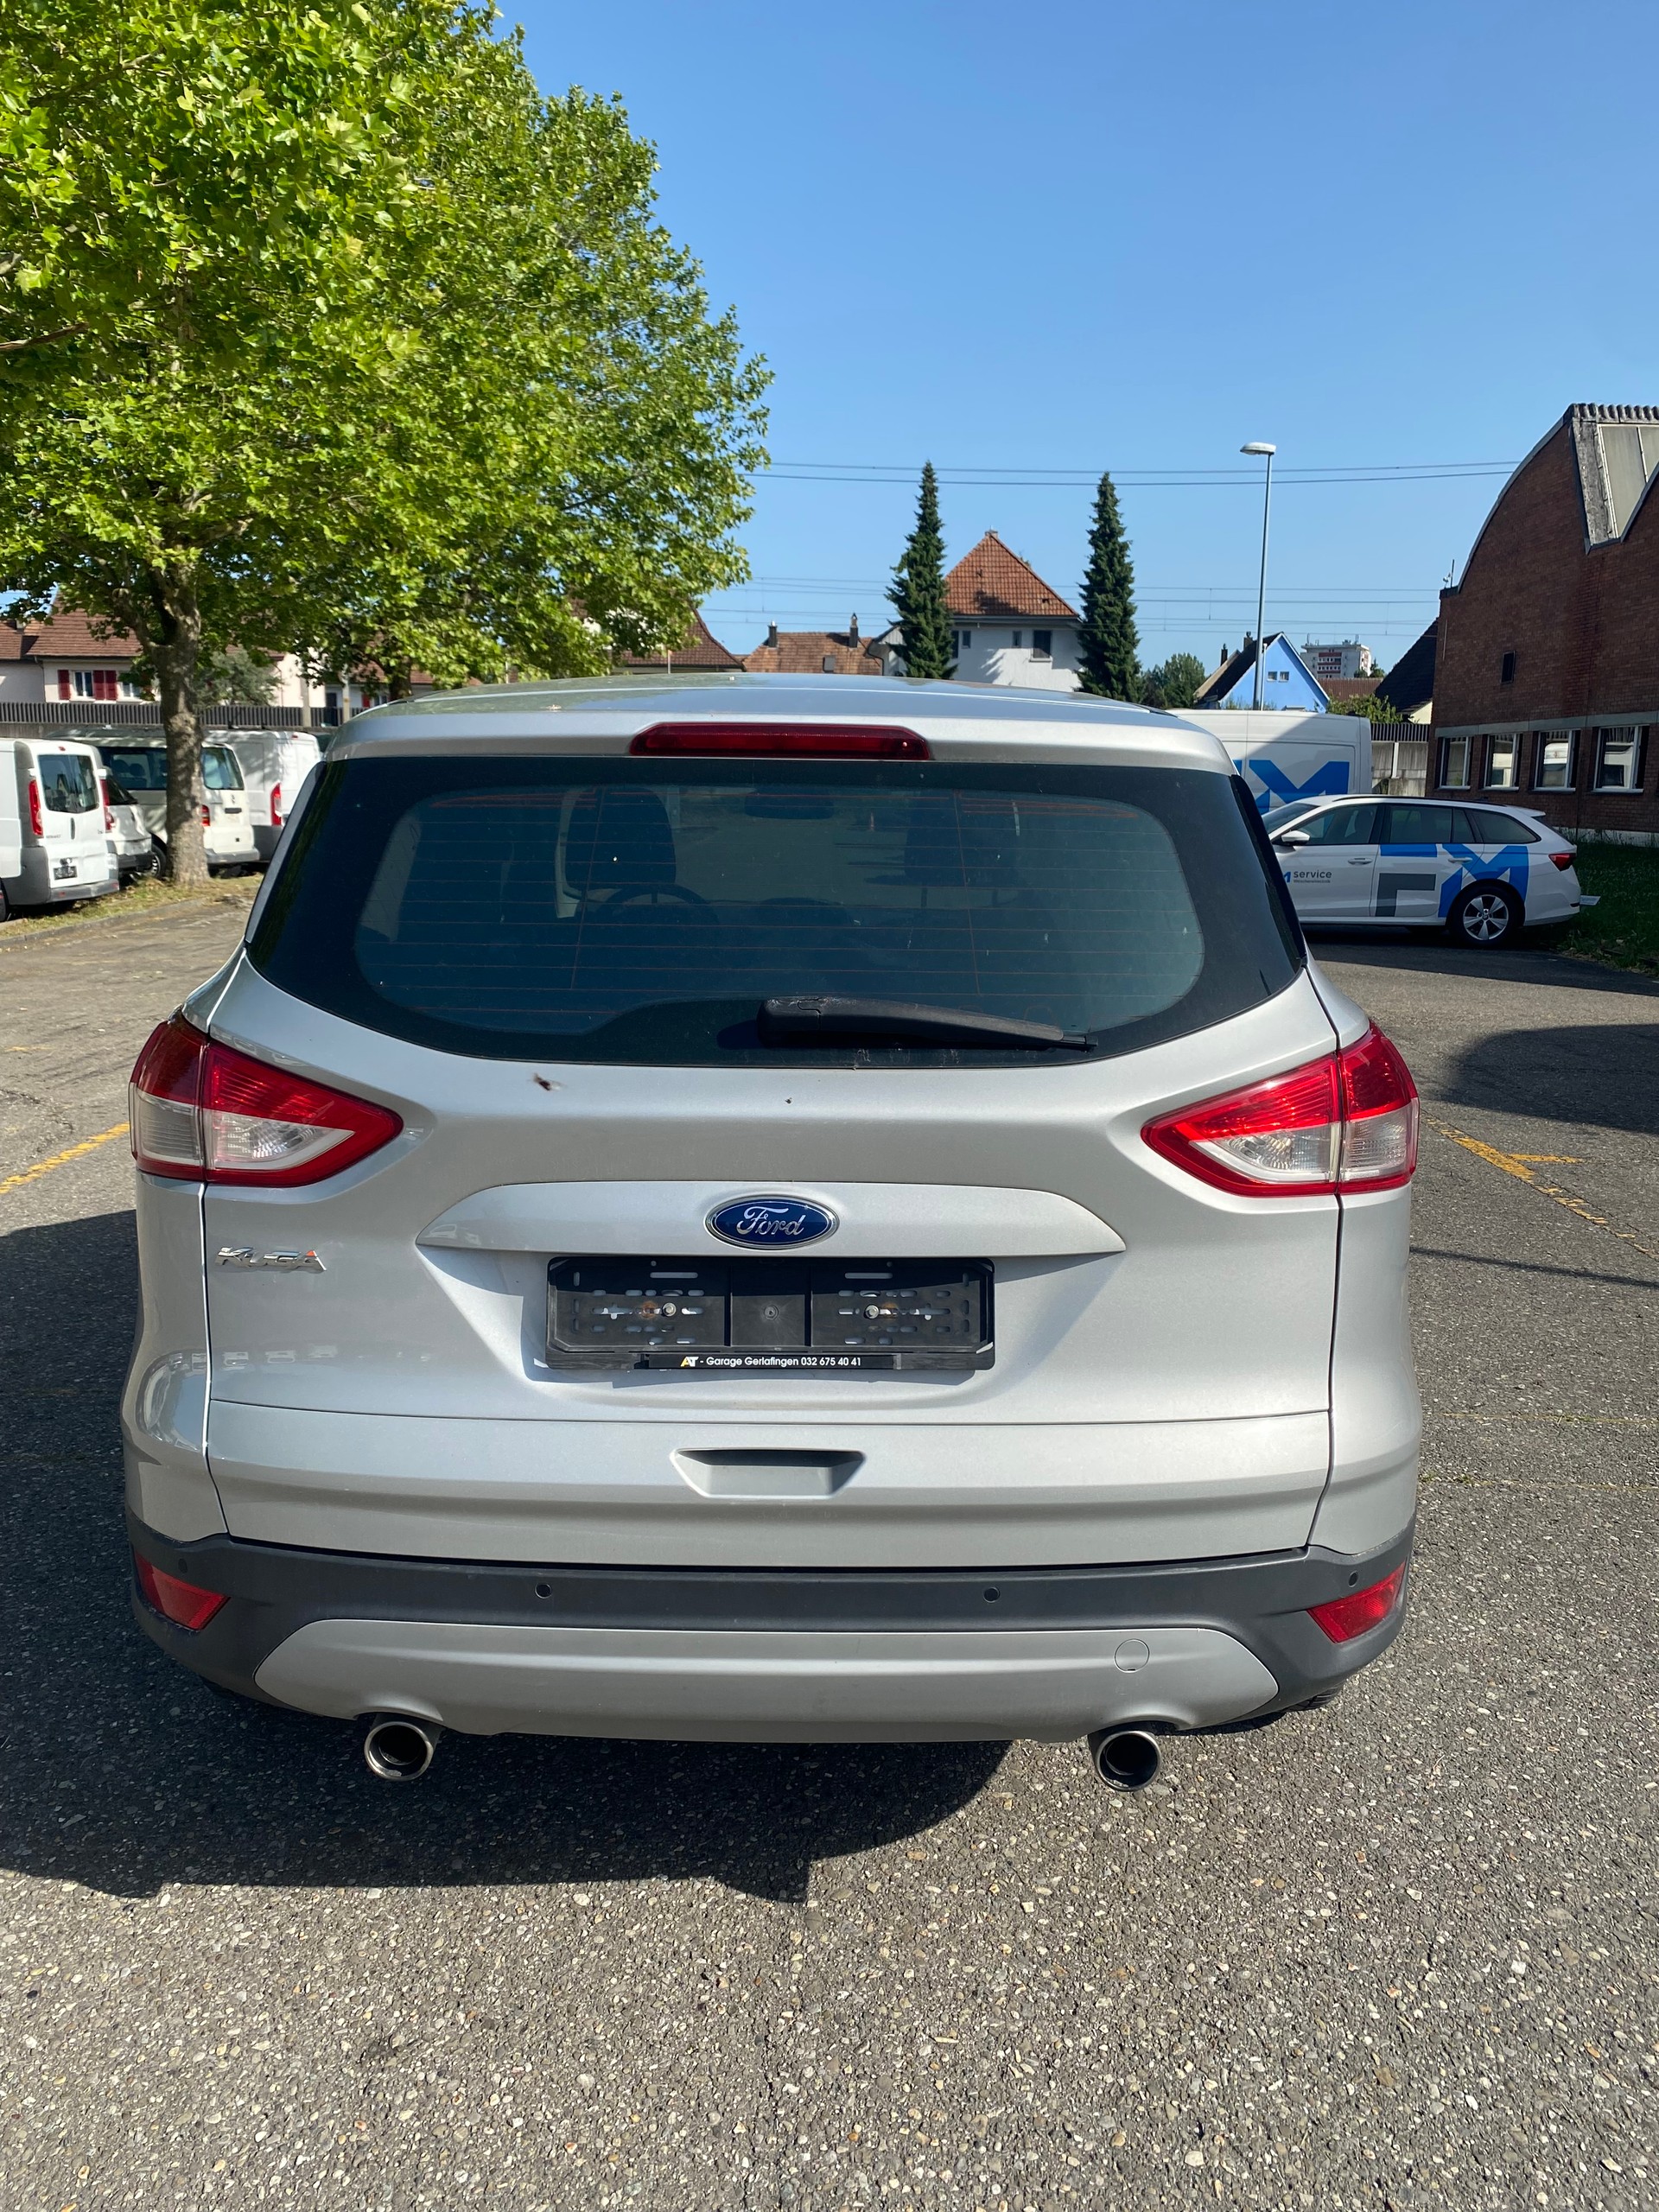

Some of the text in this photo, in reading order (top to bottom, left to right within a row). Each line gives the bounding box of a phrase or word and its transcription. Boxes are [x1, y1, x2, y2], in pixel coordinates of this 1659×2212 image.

[1294, 869, 1332, 879] service
[736, 1206, 806, 1236] Ford
[706, 1357, 742, 1368] Garage
[744, 1357, 799, 1368] Gerlafingen
[800, 1357, 817, 1366] 032
[819, 1357, 836, 1366] 675
[837, 1357, 849, 1366] 40
[850, 1357, 861, 1366] 41
